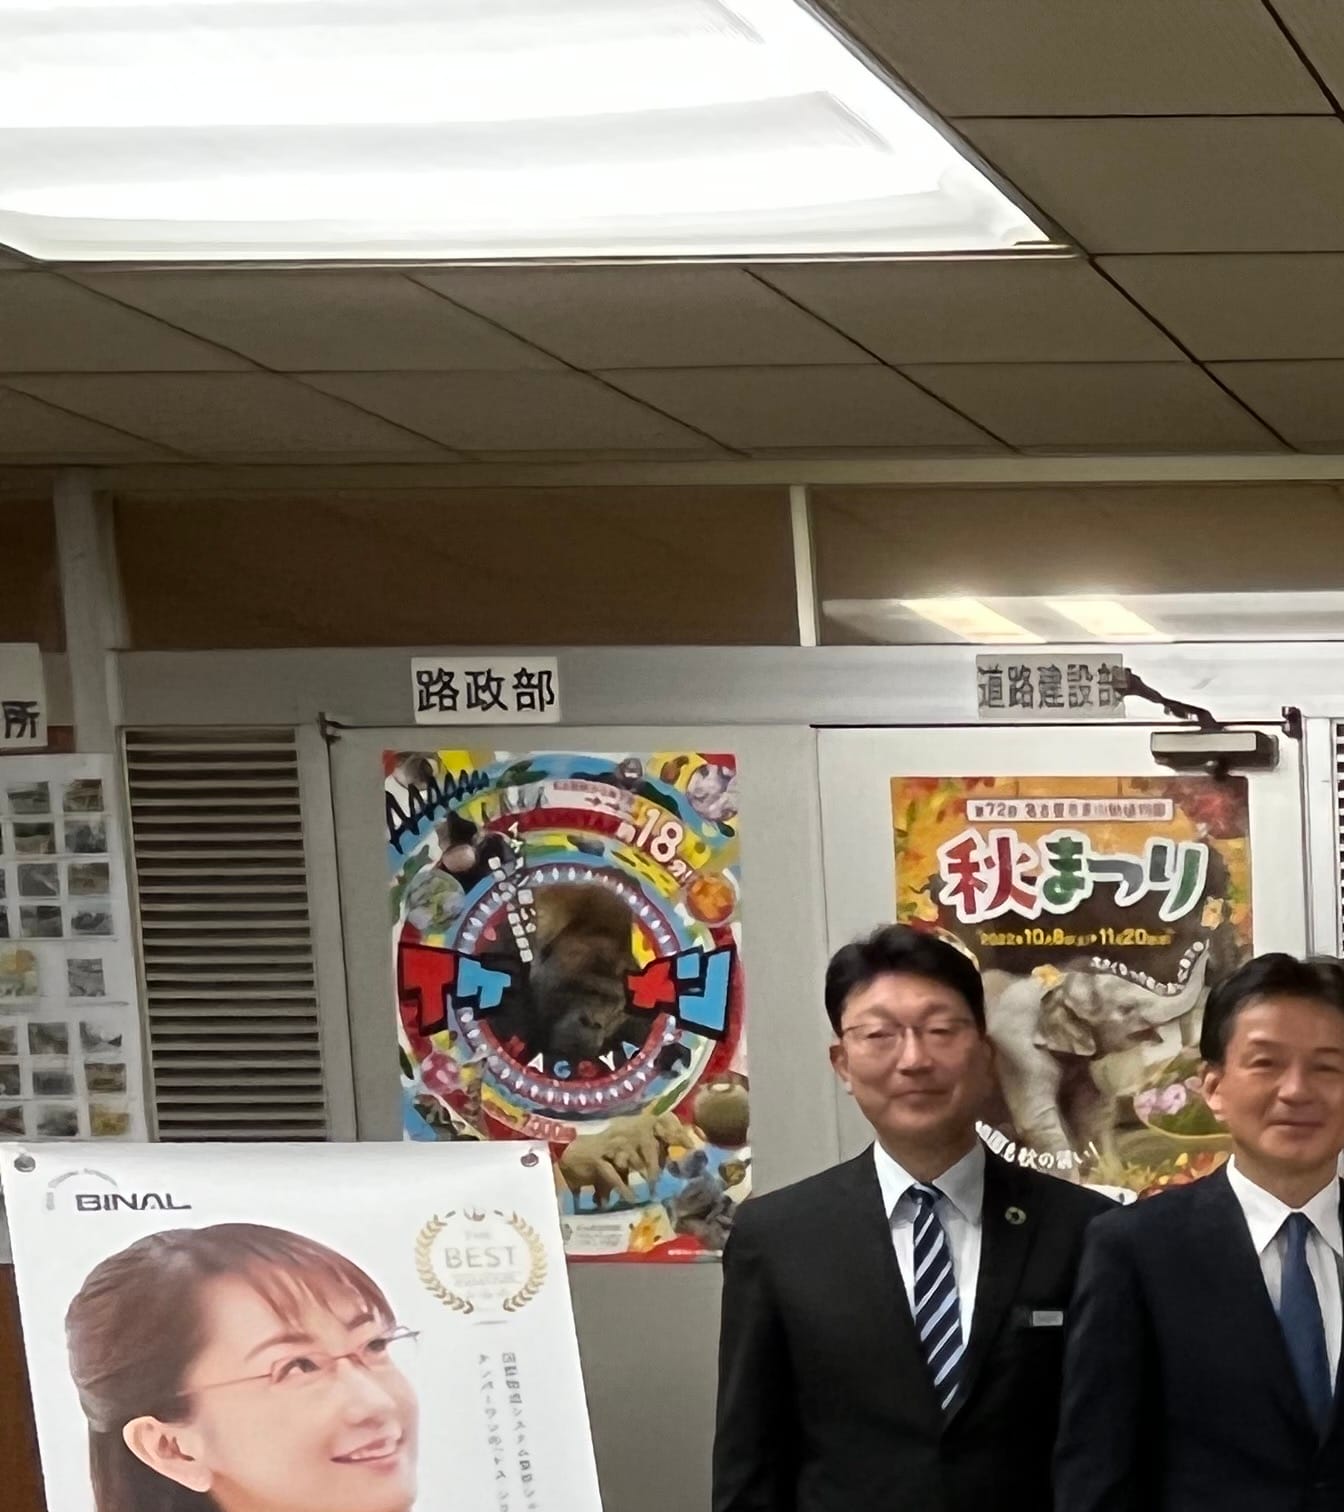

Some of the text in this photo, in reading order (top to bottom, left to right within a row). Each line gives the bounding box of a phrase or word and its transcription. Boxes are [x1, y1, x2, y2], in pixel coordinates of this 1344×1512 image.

[416, 667, 556, 713] 路政部
[977, 662, 1125, 709] 道路建設部
[940, 832, 1207, 920] 秋まつり
[76, 1193, 192, 1211] BINAL
[445, 1246, 517, 1269] BEST
